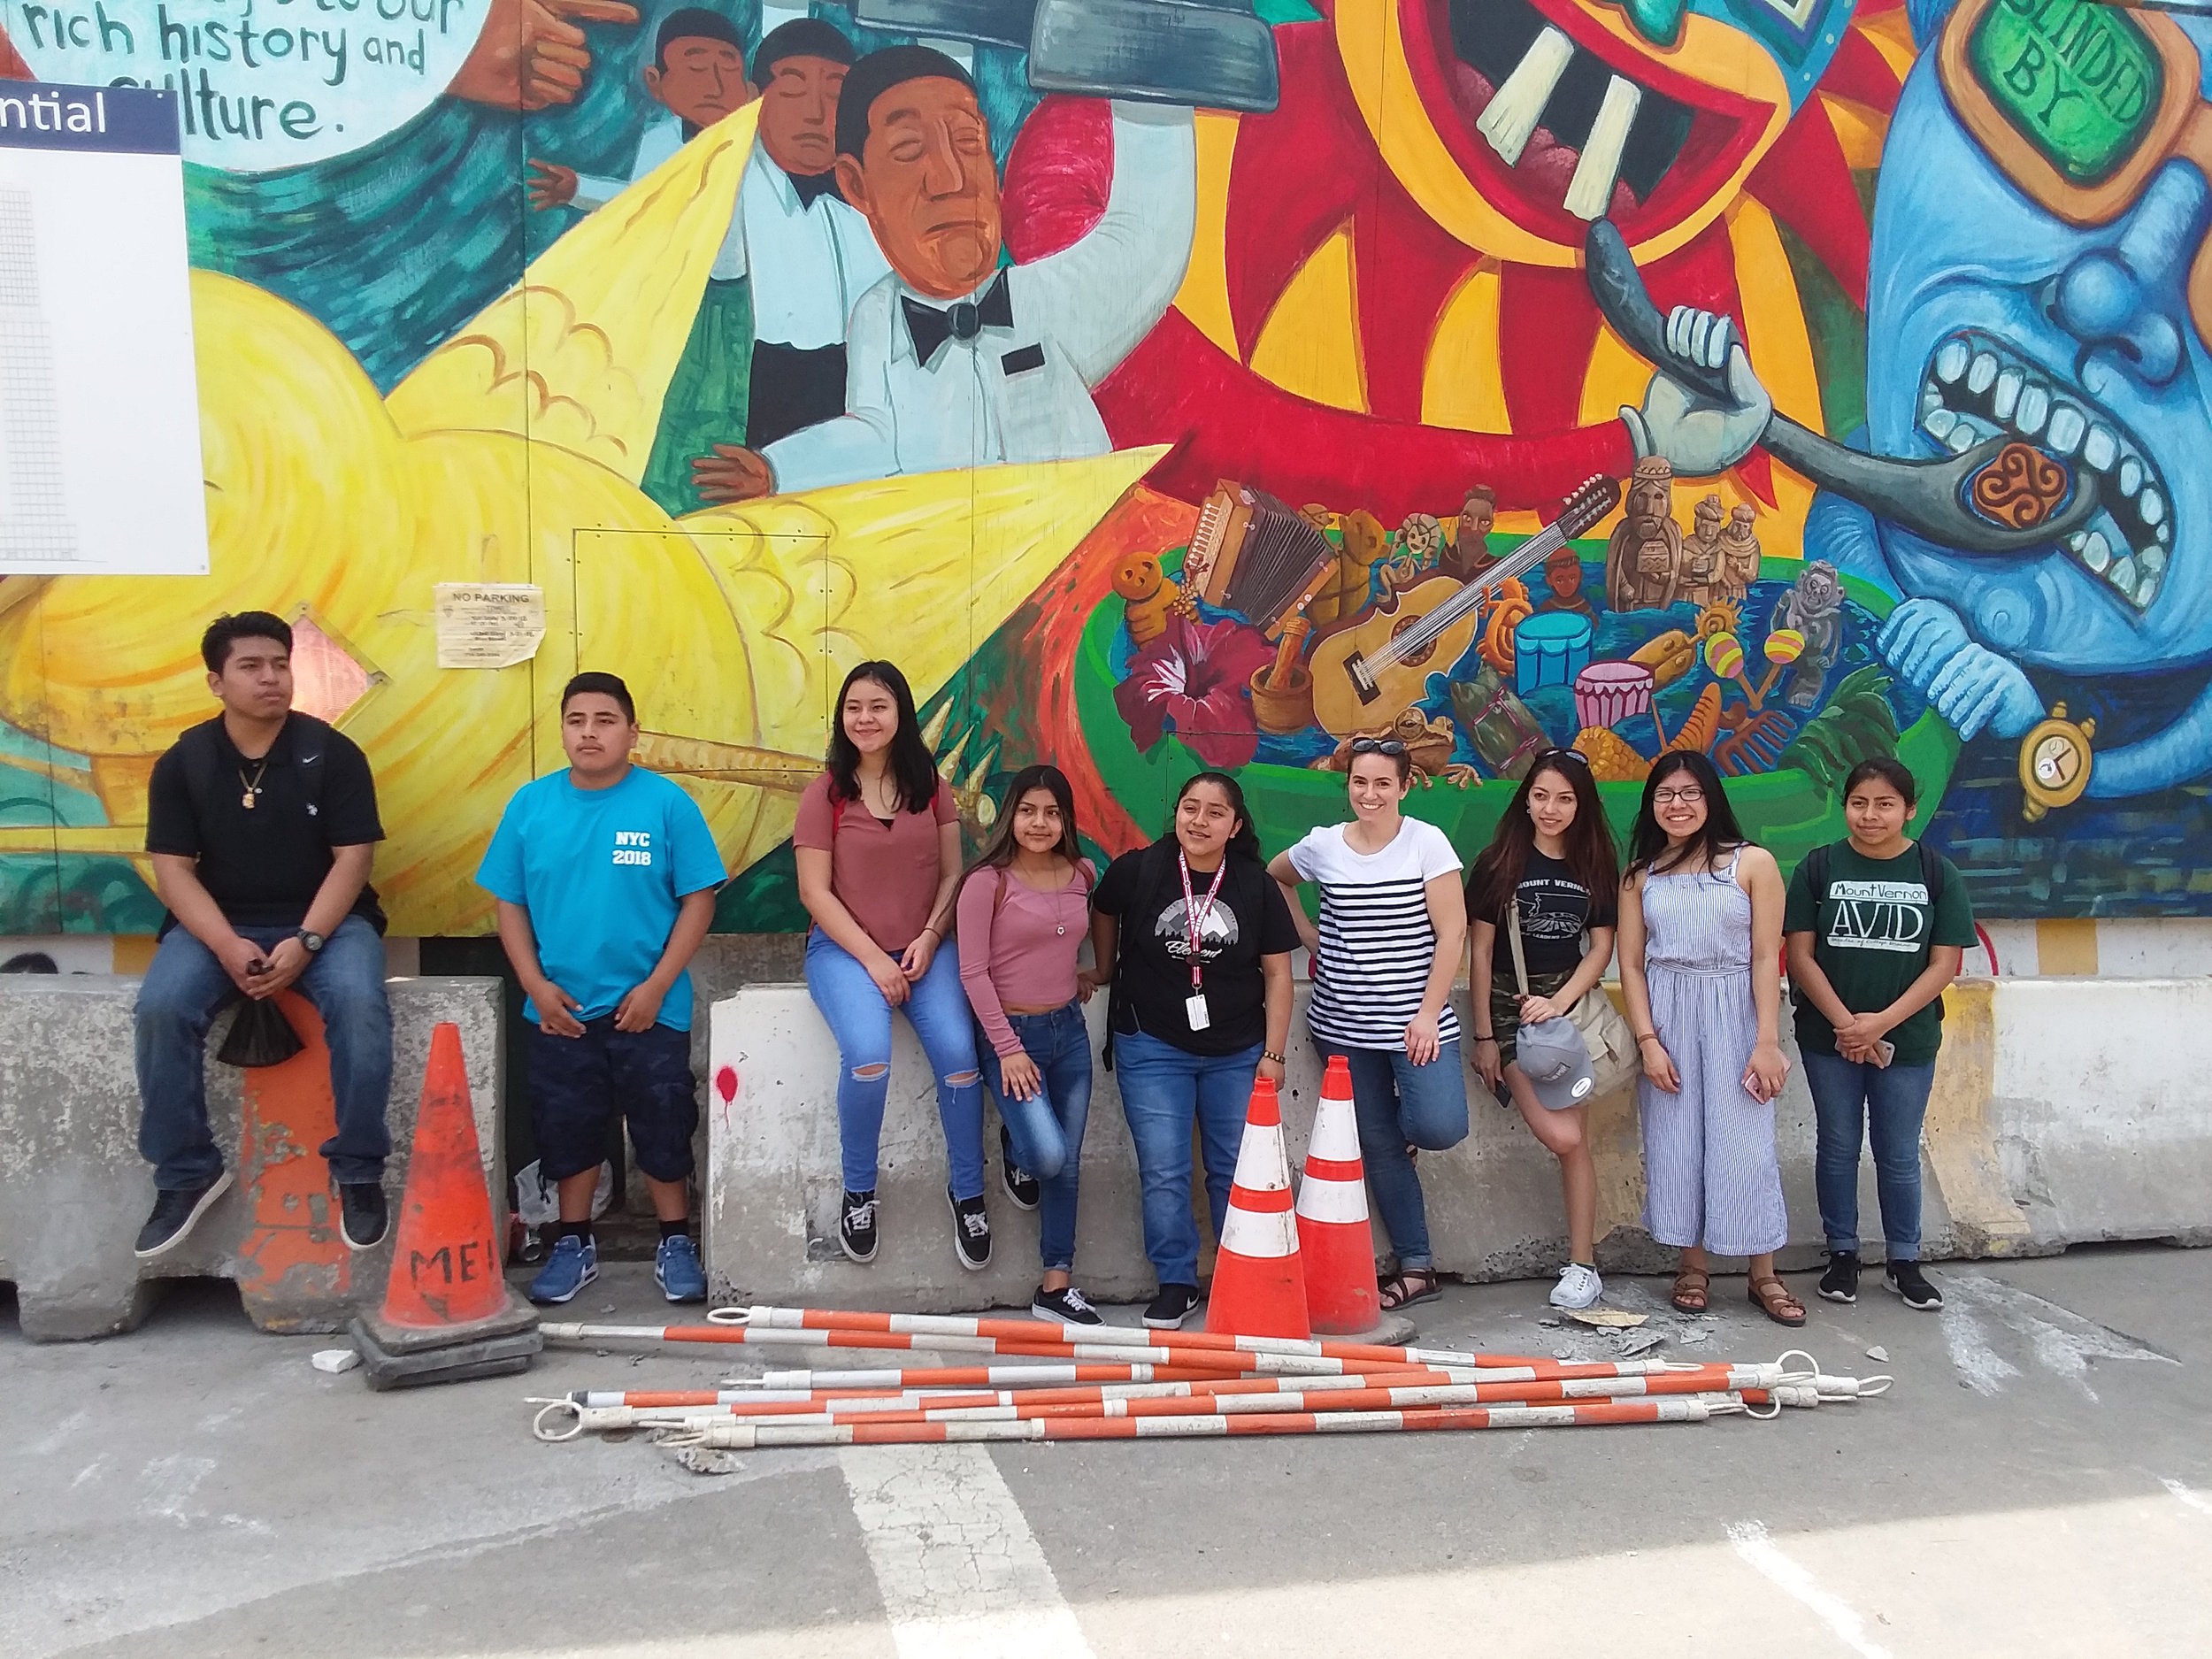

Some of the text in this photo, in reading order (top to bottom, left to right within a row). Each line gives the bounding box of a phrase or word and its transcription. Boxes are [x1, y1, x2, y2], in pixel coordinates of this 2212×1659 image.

[22, 1, 425, 86] rich history and
[2003, 35, 2085, 127] BY
[110, 68, 344, 140] lture.
[453, 593, 530, 603] NO PARKING
[615, 832, 651, 847] NYC
[612, 849, 652, 866] 2018
[1554, 879, 1592, 896] VERN
[1834, 883, 1927, 900] Mount Vernon
[1829, 901, 1924, 941] AVID
[1165, 941, 1223, 958] Eleent
